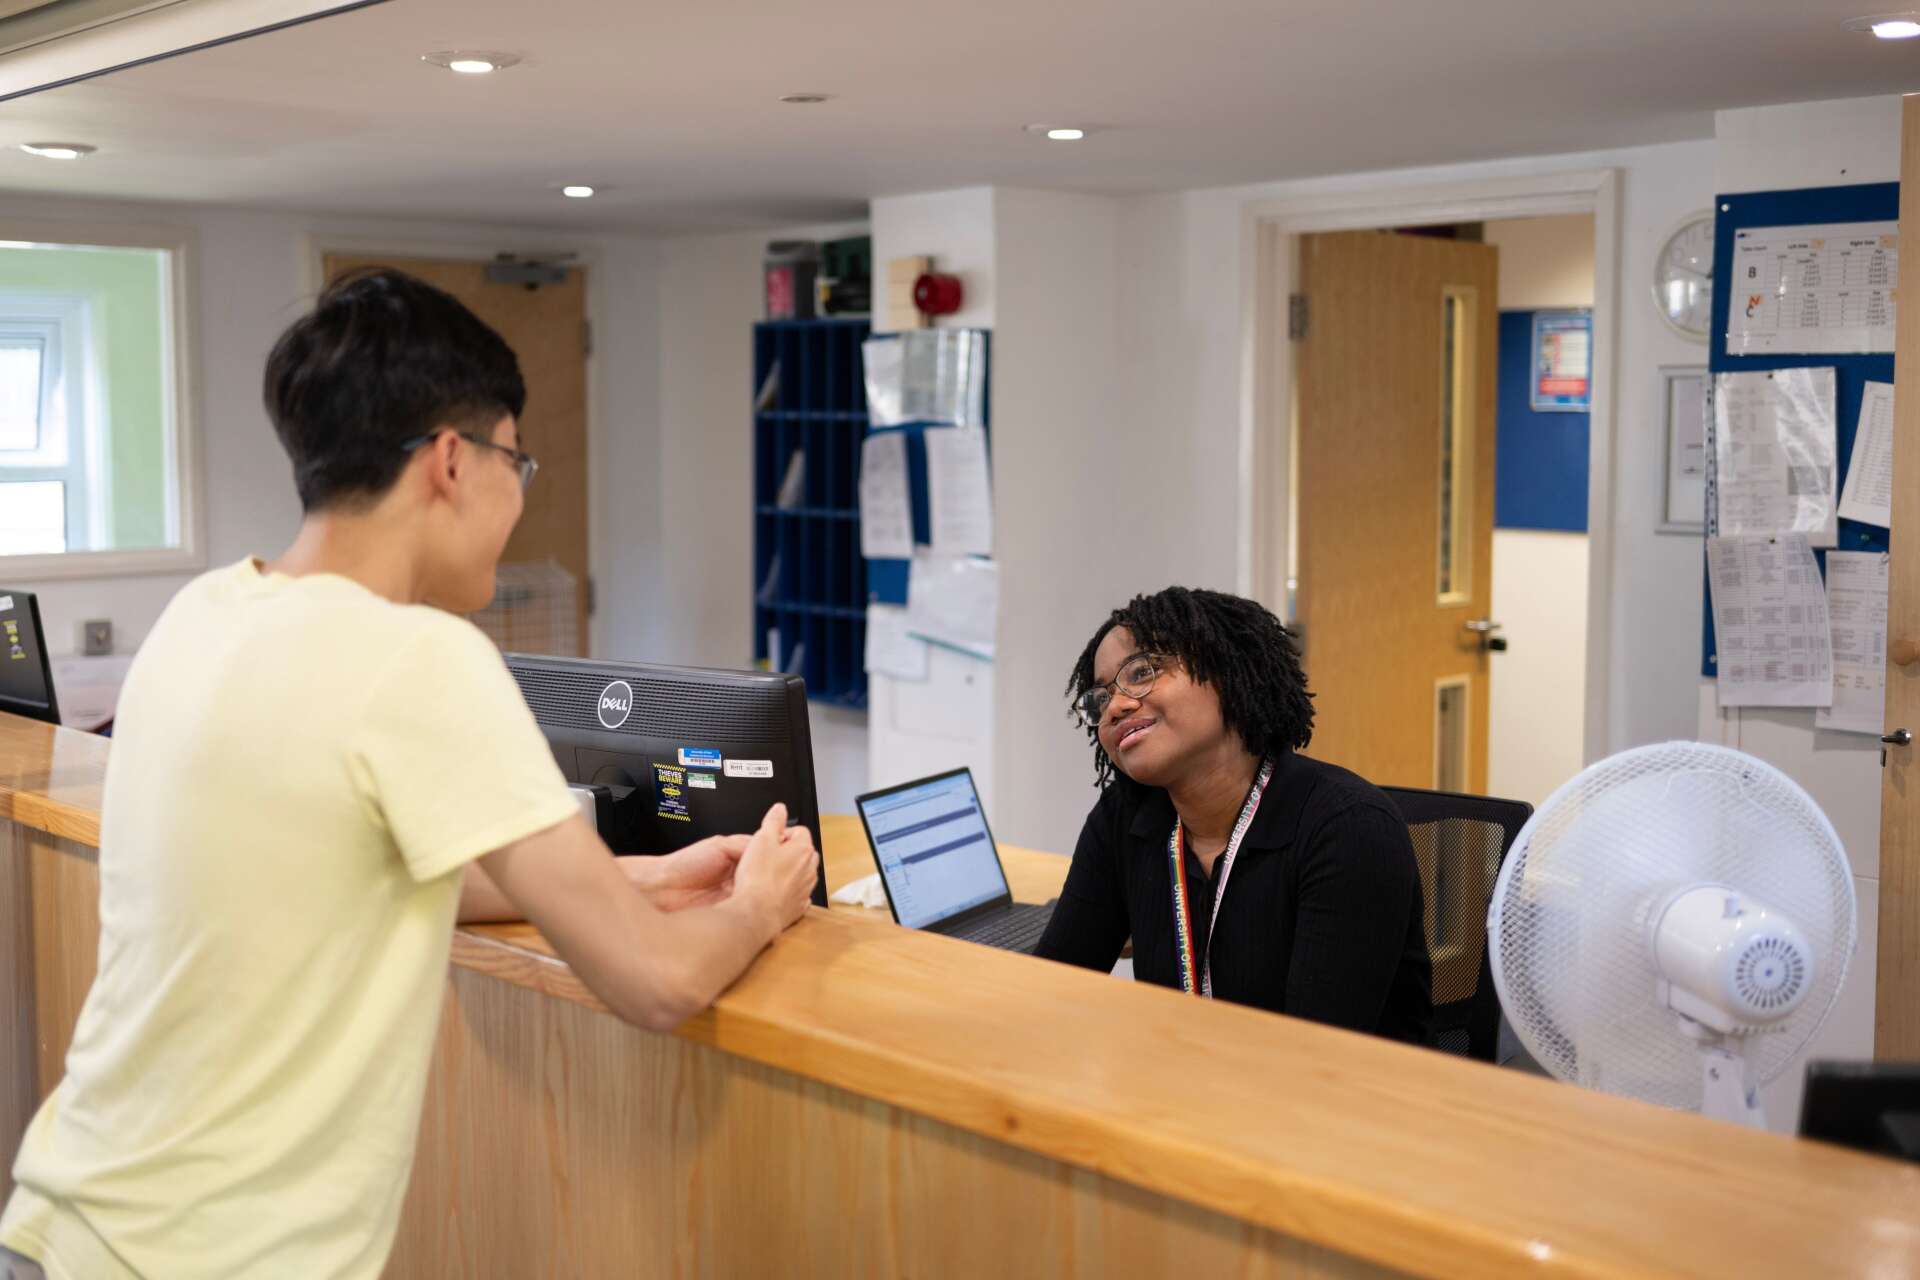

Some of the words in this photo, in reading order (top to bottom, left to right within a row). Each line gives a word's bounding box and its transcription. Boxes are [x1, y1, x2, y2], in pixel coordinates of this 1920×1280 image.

[1748, 266, 1757, 279] B
[601, 697, 628, 711] DELL
[657, 768, 682, 779] THIEVES
[658, 774, 683, 785] BEWARE
[1223, 801, 1255, 865] UNIVERSITY
[1173, 883, 1189, 951] UNIVERSITY
[1180, 953, 1191, 970] OF
